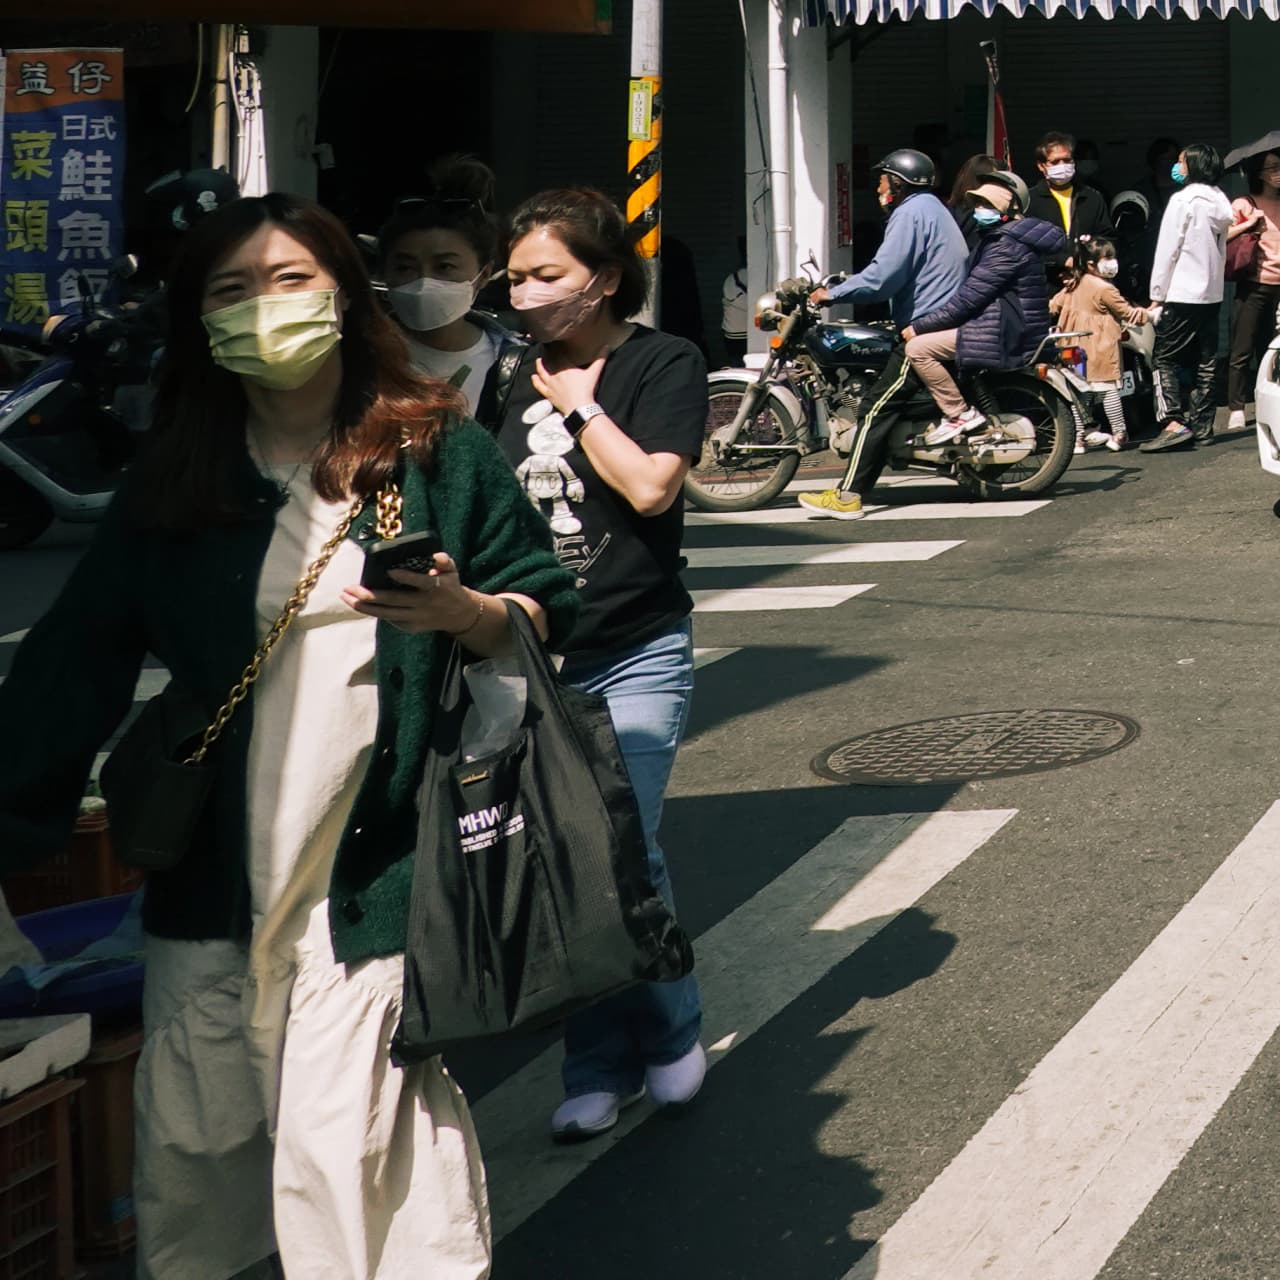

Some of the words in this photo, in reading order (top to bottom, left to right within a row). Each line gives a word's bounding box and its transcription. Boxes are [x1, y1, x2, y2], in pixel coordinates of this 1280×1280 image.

[61, 113, 118, 141] 日式
[5, 130, 57, 325] 菜頭湯
